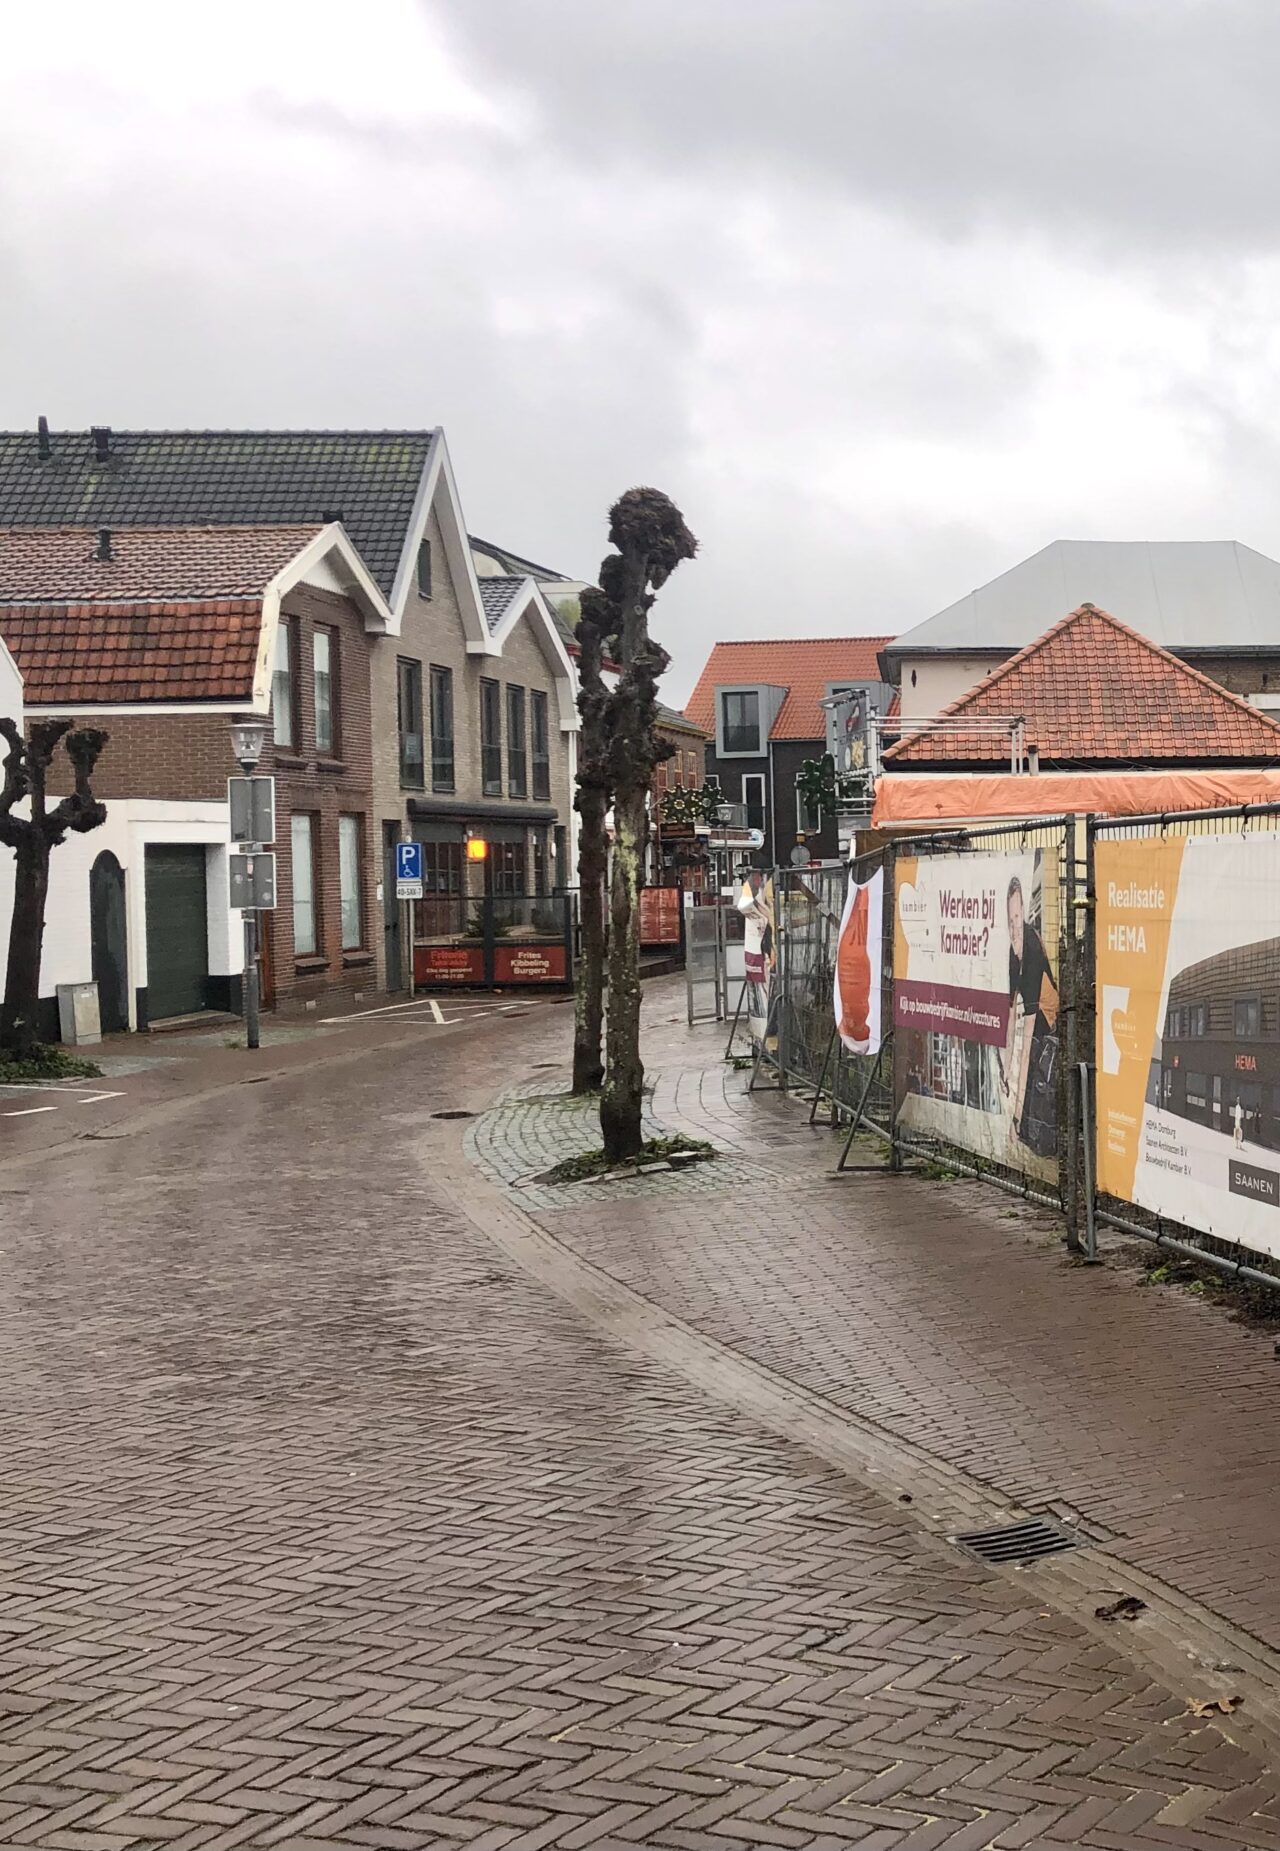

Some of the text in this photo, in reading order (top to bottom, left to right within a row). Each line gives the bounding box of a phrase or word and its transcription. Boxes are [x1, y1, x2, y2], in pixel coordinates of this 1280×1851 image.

[402, 846, 416, 865] P
[1108, 881, 1165, 909] Realisatie
[939, 889, 996, 929] Werken bij
[940, 924, 989, 957] Kambier?
[1108, 924, 1147, 953] HEMA
[510, 959, 550, 968] Kibbeling
[513, 967, 547, 976] Burgers
[1235, 1053, 1257, 1072] HEMA
[1234, 1172, 1274, 1195] SAANEN
